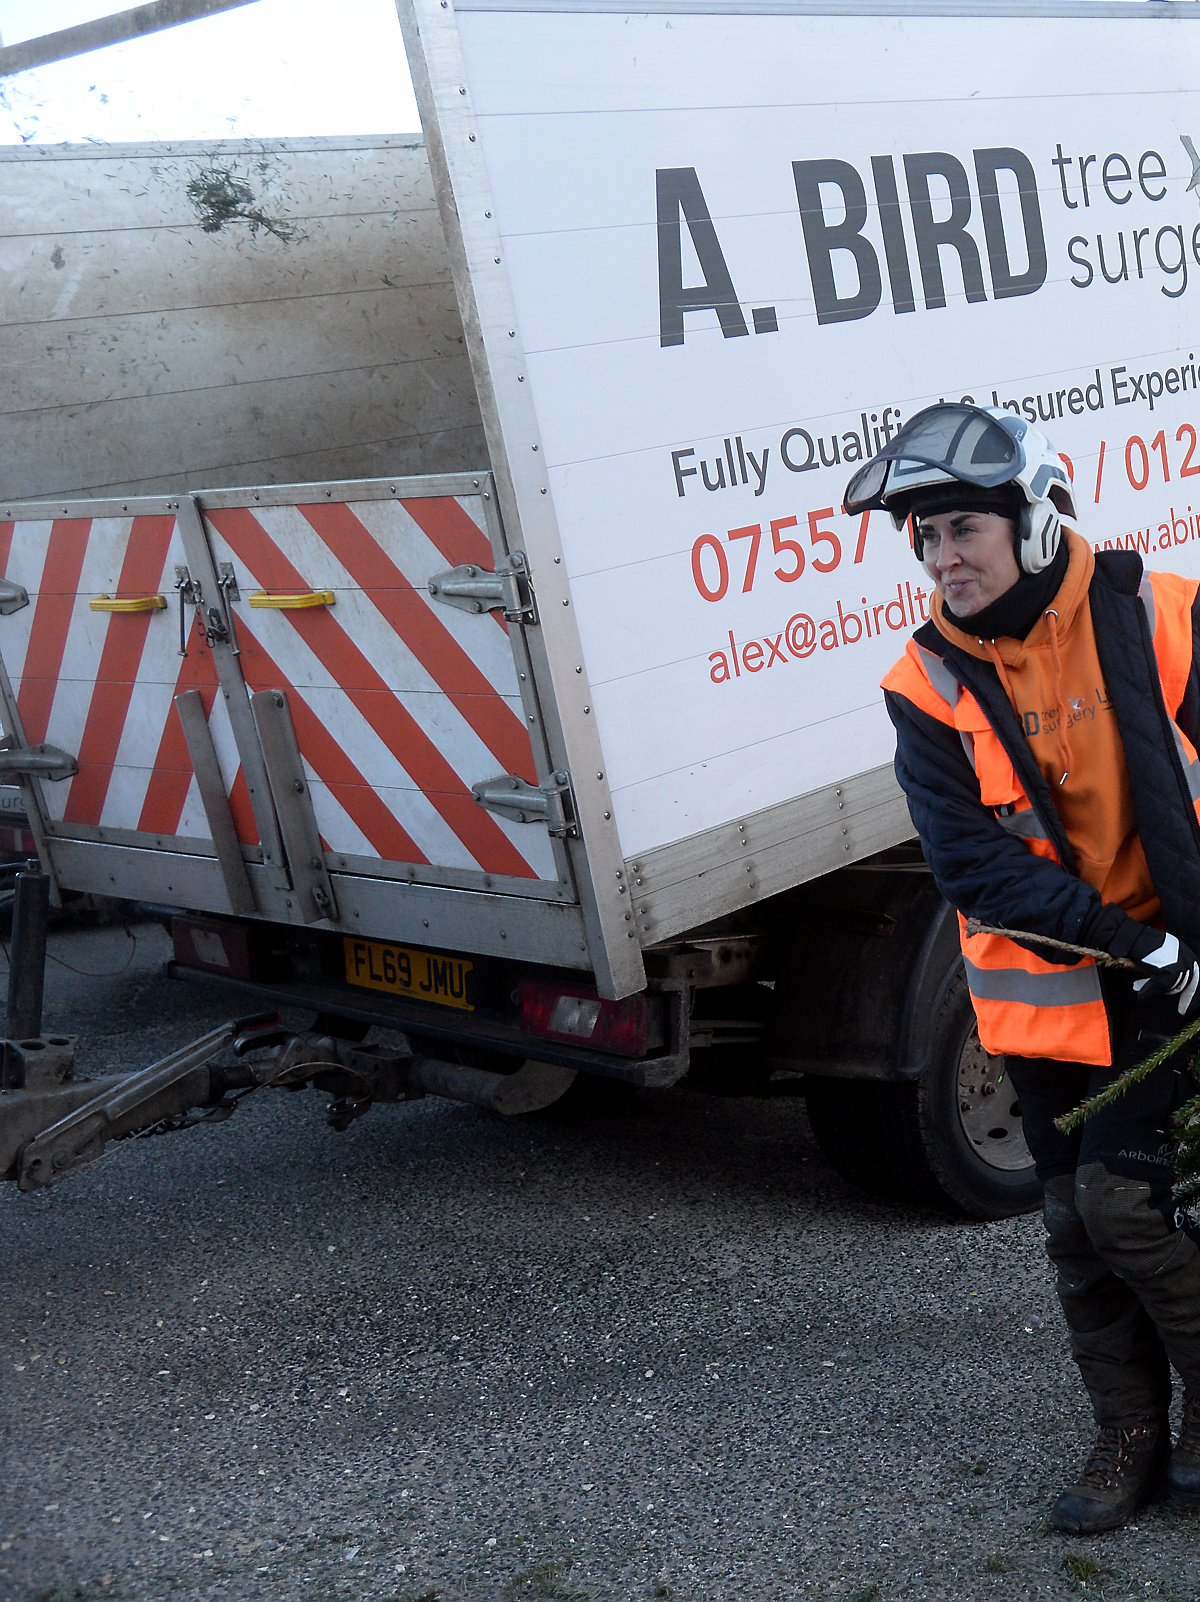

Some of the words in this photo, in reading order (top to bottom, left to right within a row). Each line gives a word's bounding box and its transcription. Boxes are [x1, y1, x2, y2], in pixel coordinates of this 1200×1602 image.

[1052, 143, 1168, 209] tree
[656, 166, 778, 347] A.
[791, 147, 1049, 326] BIRD
[671, 436, 769, 497] Fully
[780, 397, 944, 473] Qualifi
[708, 581, 934, 684] alex@abirdlt
[353, 943, 412, 987] FL69
[420, 957, 464, 998] JMU
